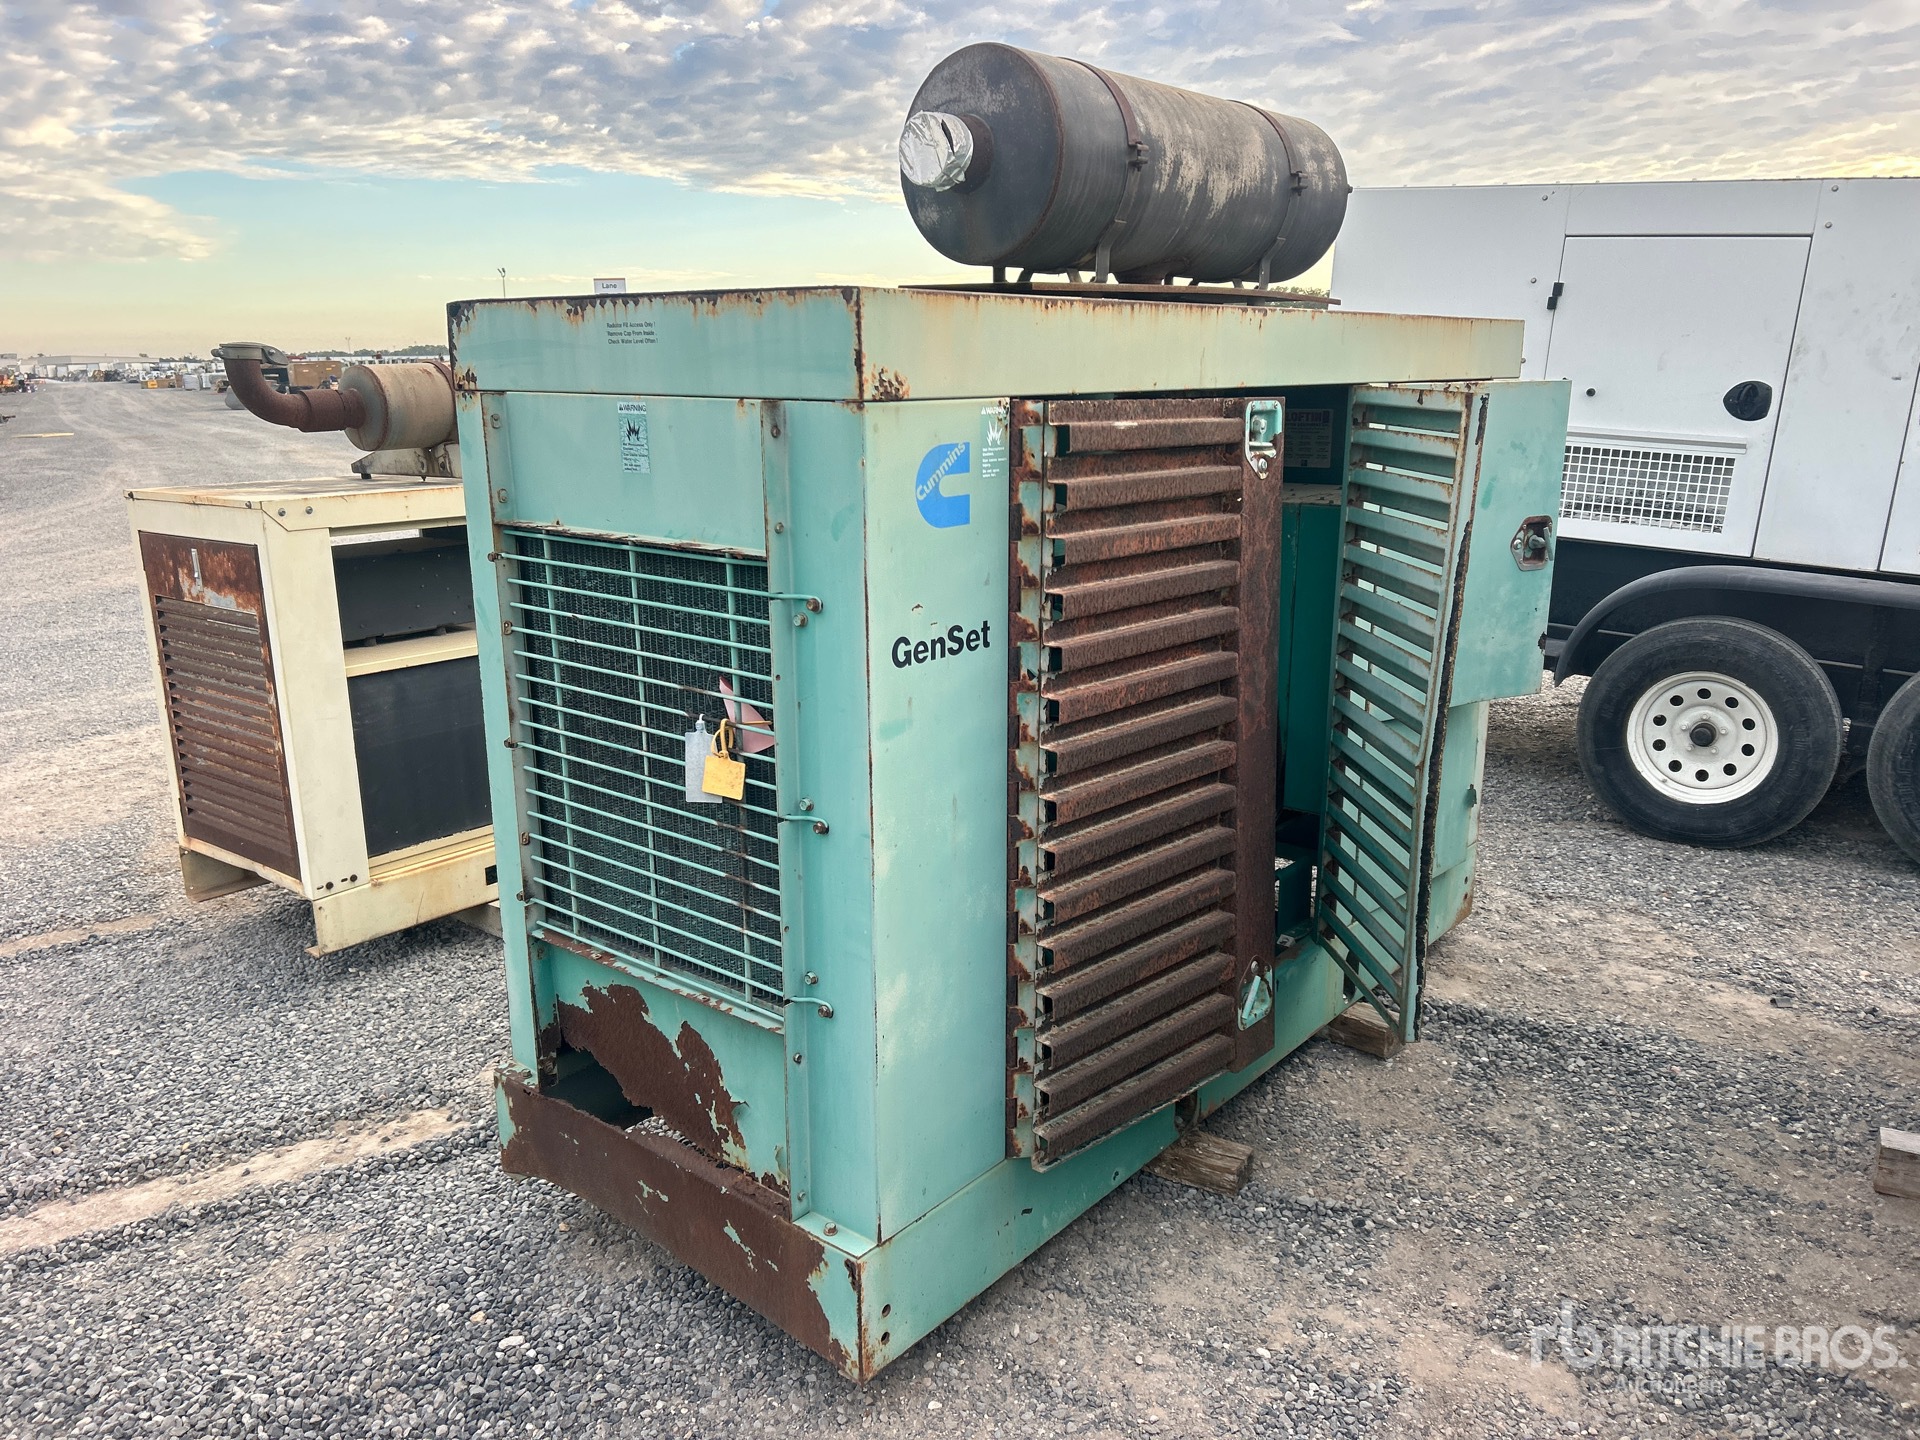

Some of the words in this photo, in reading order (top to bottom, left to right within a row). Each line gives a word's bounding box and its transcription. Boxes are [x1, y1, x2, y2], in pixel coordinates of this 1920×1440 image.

[623, 404, 647, 412] WARNING
[916, 441, 966, 501] Cummins
[891, 620, 991, 669] GenSet
